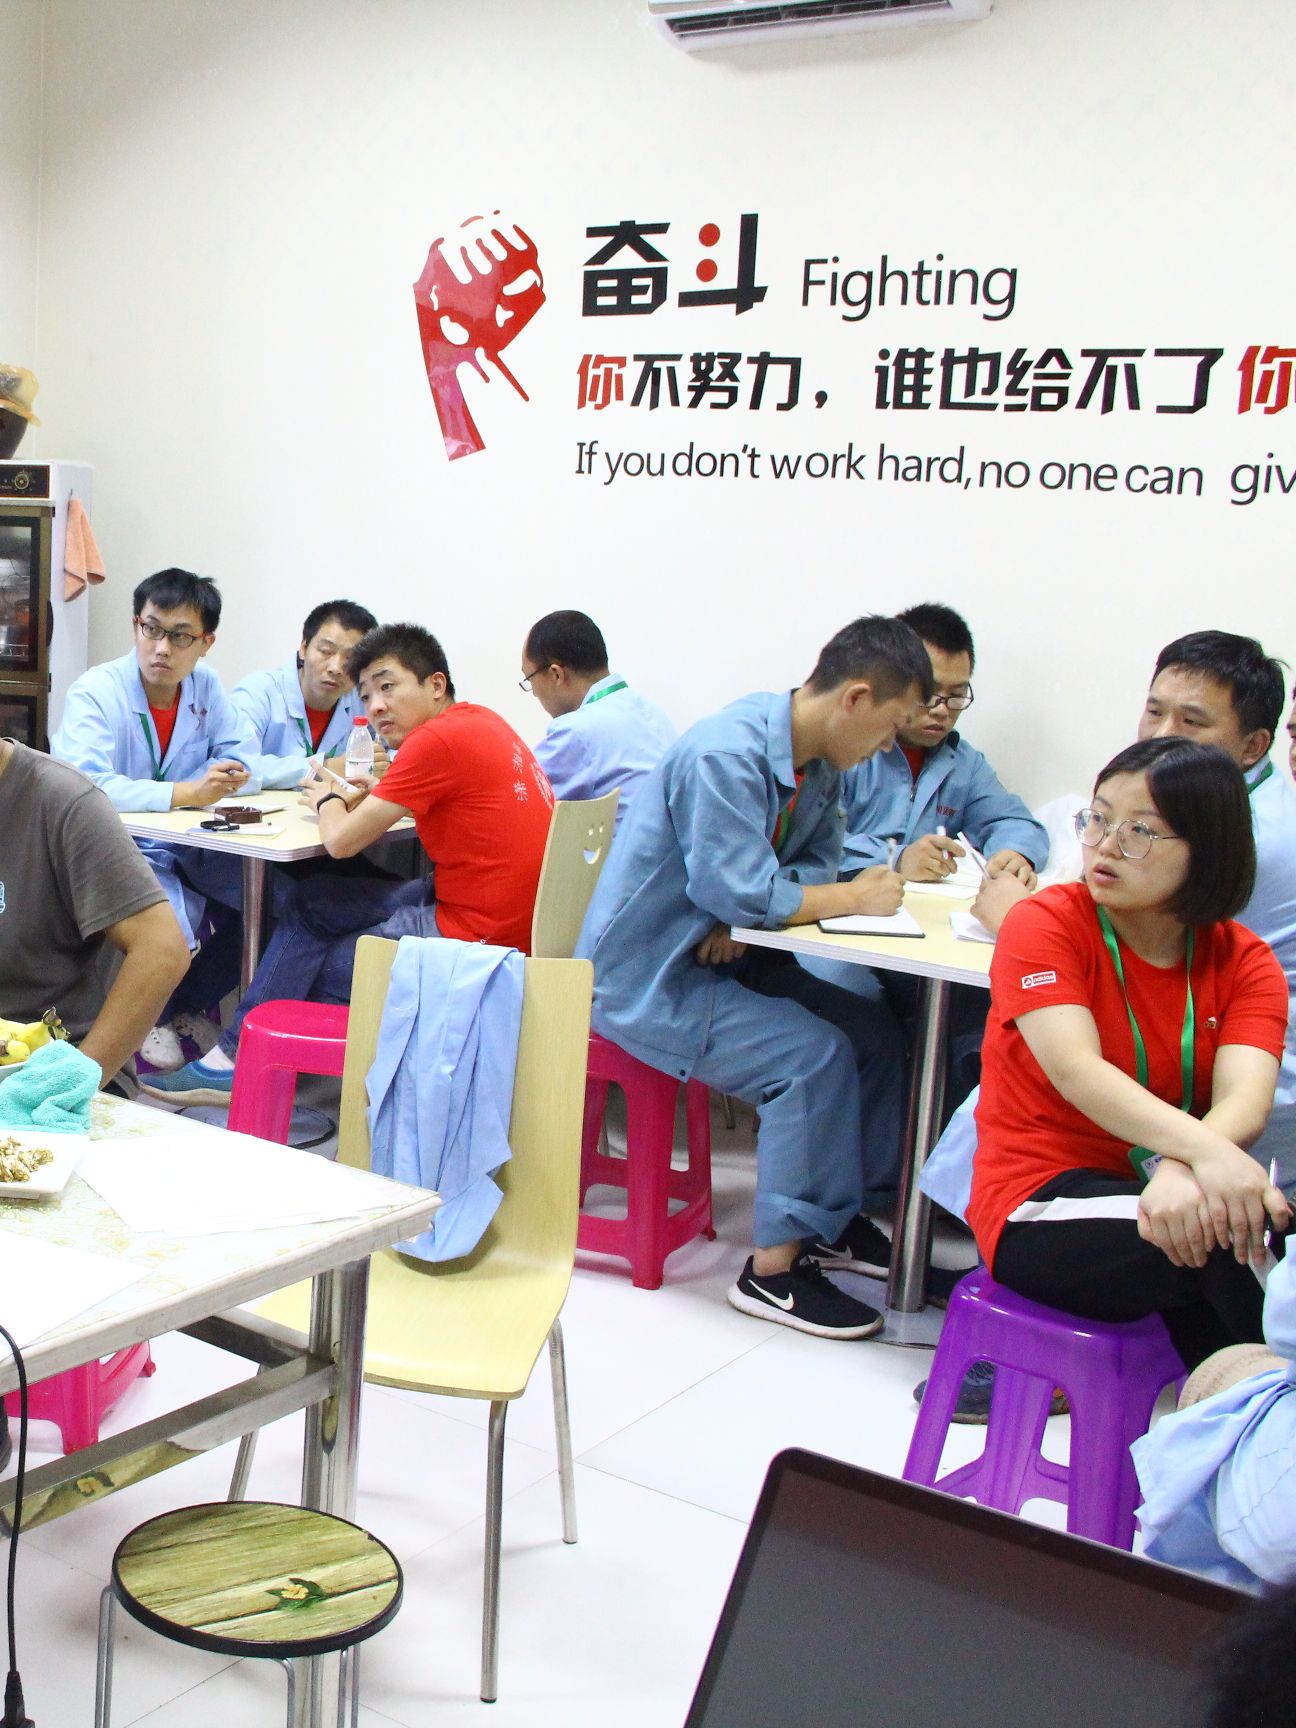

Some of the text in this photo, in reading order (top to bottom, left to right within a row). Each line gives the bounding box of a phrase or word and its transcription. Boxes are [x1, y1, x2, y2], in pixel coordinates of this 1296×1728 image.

[581, 212, 769, 316] 奋斗
[801, 253, 1018, 323] Fighting
[575, 440, 599, 475] If
[603, 452, 665, 486] you
[770, 442, 866, 480] work
[1039, 461, 1118, 492] one
[1125, 464, 1204, 497] can
